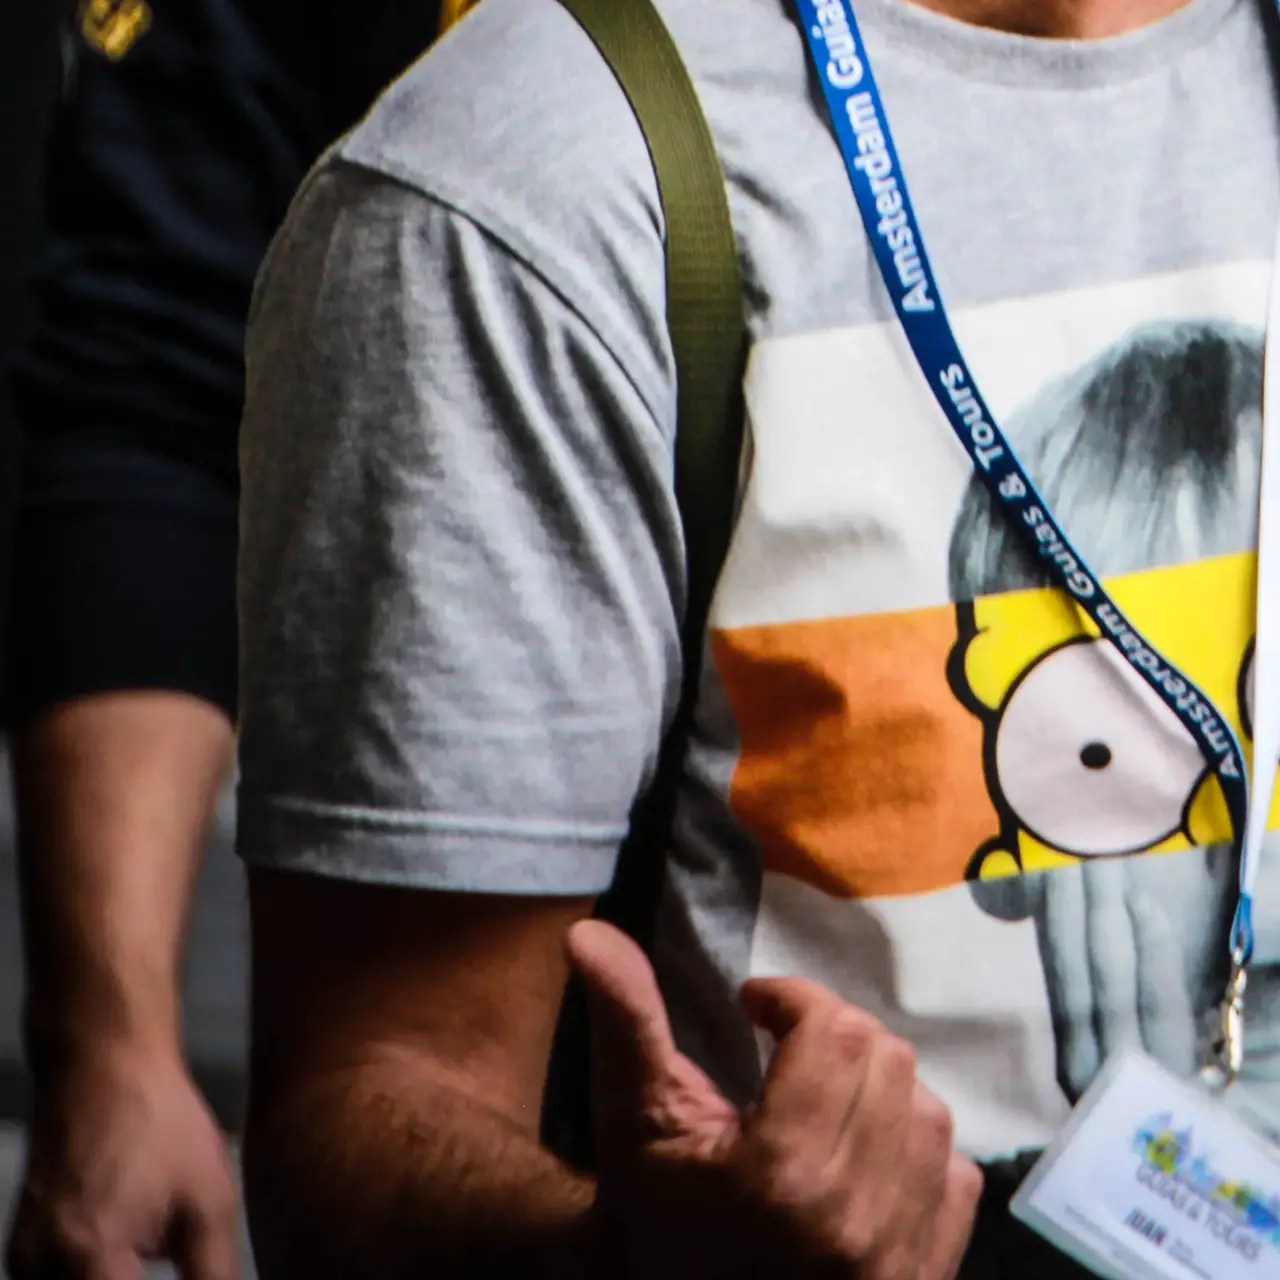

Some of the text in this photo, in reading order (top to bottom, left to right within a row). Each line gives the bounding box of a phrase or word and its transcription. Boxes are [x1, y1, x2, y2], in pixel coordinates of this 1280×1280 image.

[845, 91, 936, 312] Amsterdam
[939, 362, 1241, 778] Amsterdam Guias & Tours
